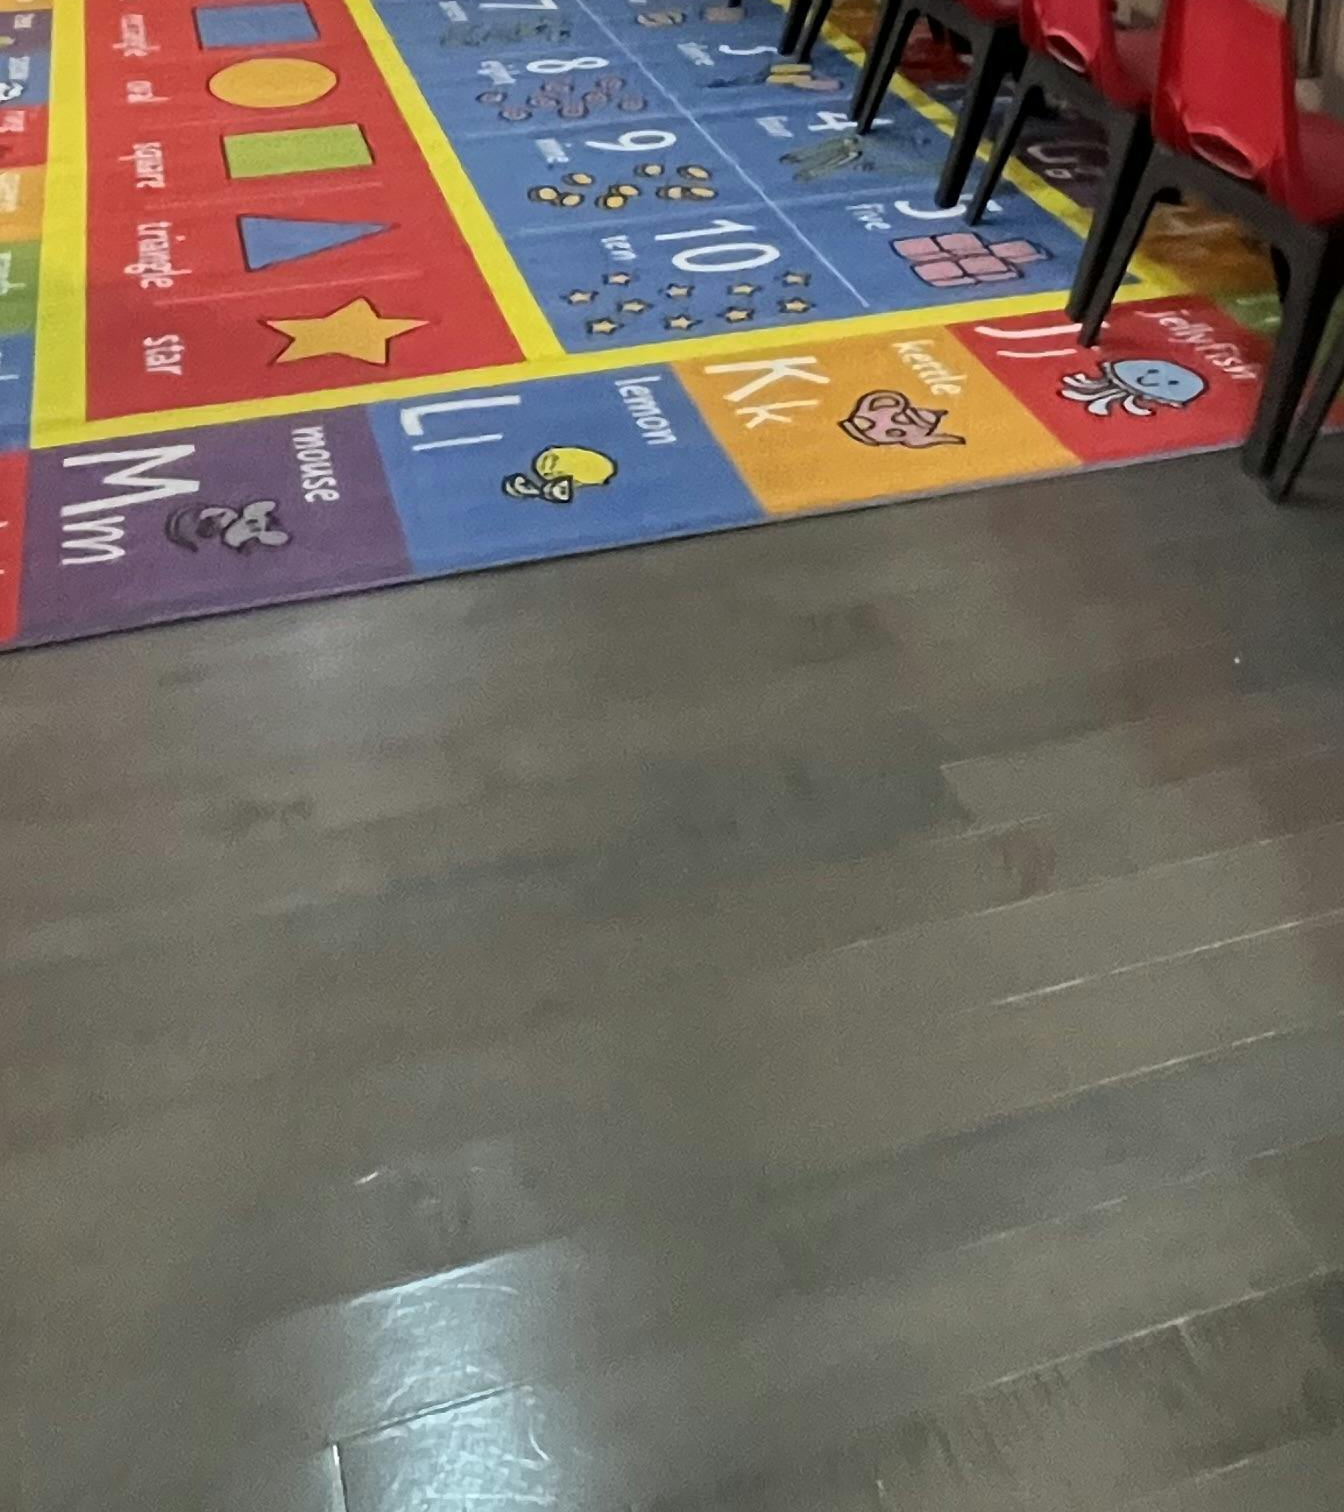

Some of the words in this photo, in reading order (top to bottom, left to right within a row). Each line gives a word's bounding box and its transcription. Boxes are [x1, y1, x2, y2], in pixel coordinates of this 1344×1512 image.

[526, 56, 610, 75] 8
[585, 131, 676, 151] 9
[654, 219, 780, 272] 10
[142, 333, 186, 376] star
[892, 340, 961, 397] kettle
[615, 376, 677, 446] lemon
[704, 356, 831, 429] Kk
[400, 395, 523, 452] Ll
[292, 425, 341, 503] mouse
[60, 444, 200, 566] Mm
